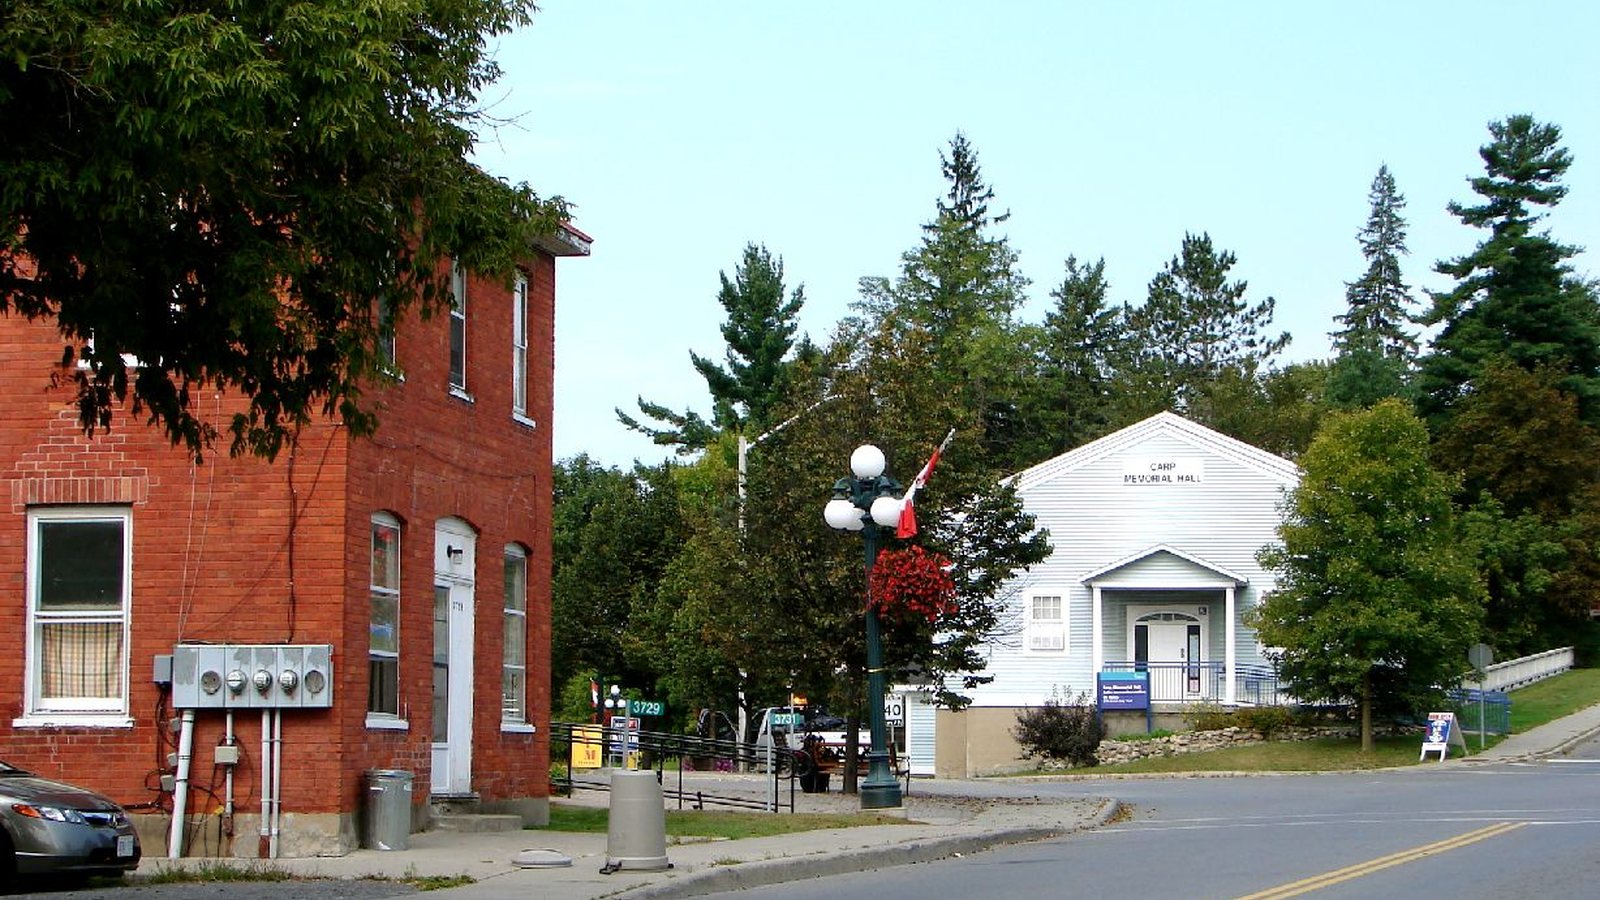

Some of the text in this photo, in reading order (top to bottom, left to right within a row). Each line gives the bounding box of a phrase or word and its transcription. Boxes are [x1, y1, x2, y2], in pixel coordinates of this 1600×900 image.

[1150, 462, 1176, 471] CARP
[1124, 474, 1201, 483] MEMORIAL HALL
[633, 701, 660, 715] 3729
[884, 704, 901, 716] 40
[774, 713, 796, 724] 3731
